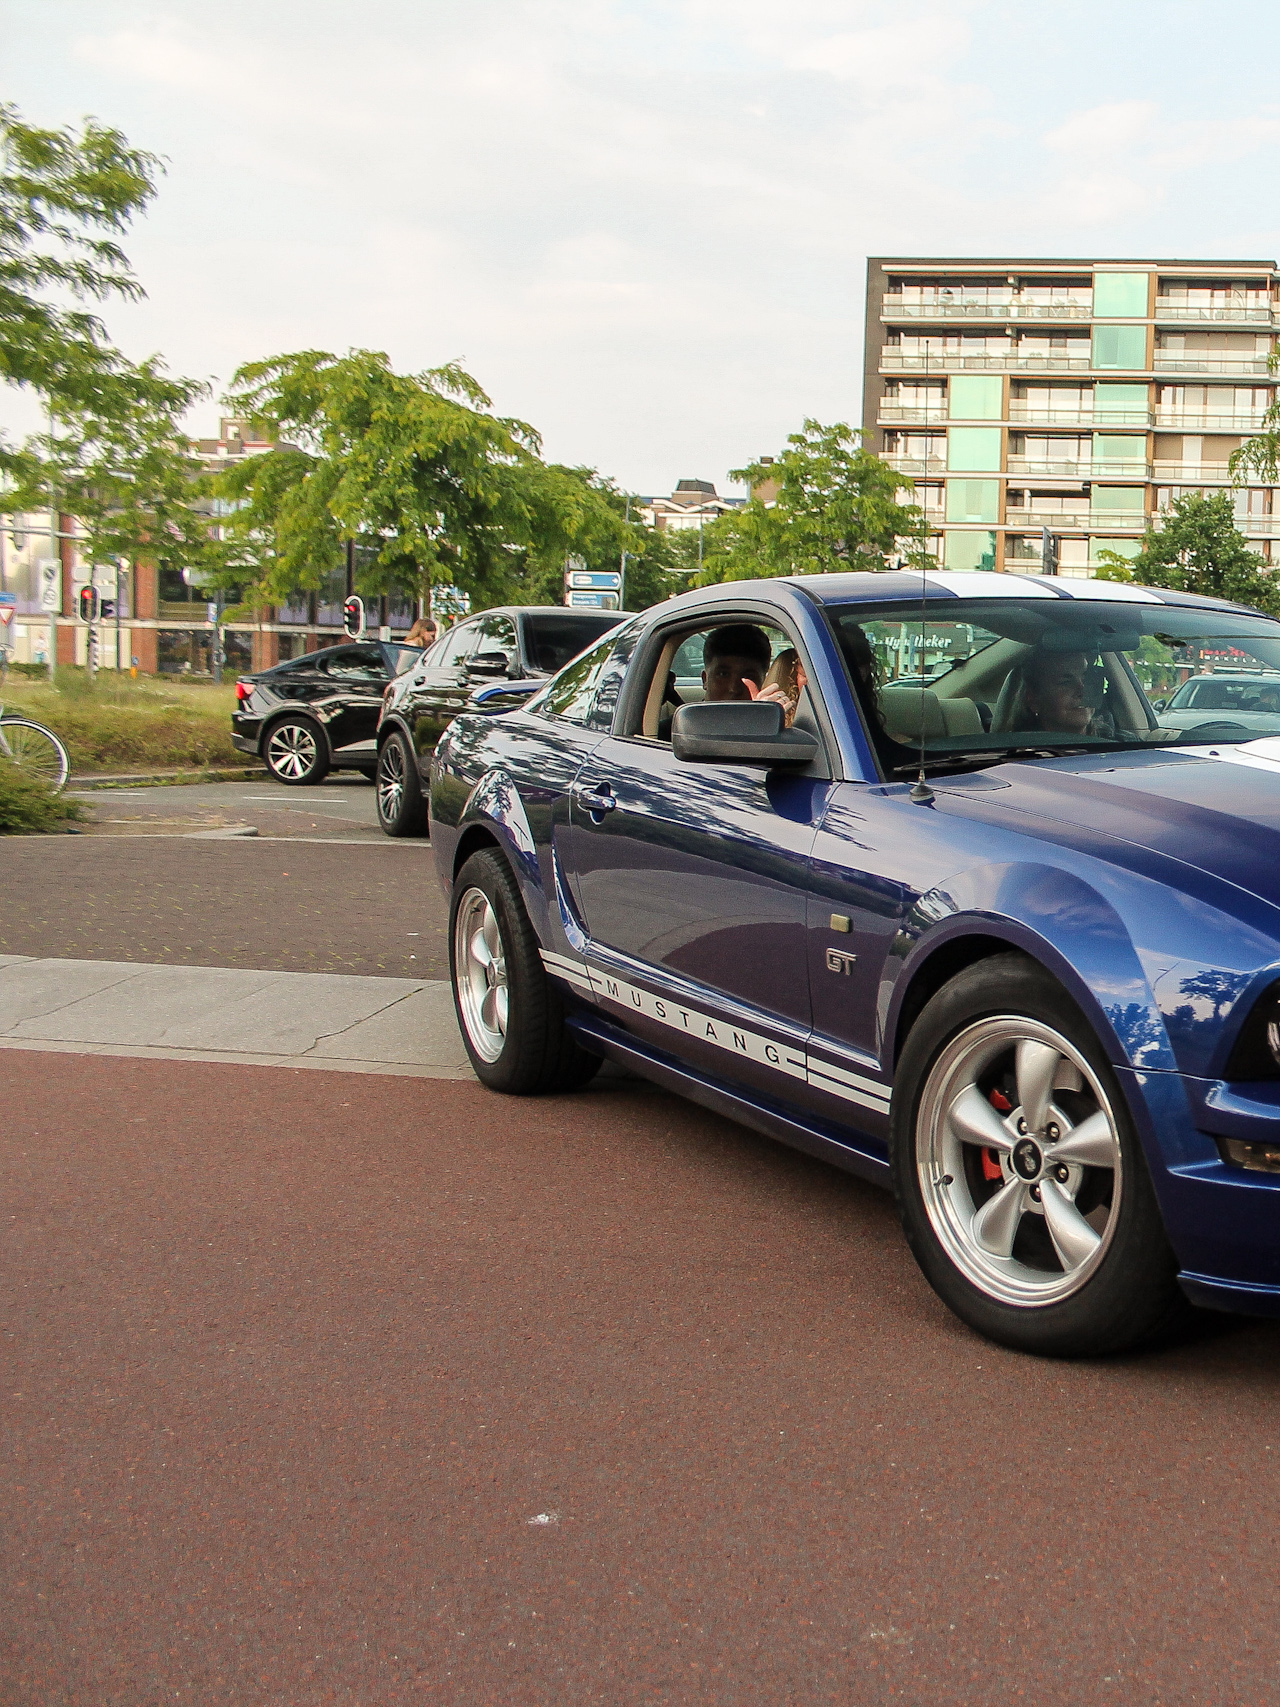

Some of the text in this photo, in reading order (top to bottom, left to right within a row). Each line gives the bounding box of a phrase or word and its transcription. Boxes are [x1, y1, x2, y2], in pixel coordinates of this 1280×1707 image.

[885, 634, 952, 650] Hytheker
[826, 947, 857, 976] GT
[606, 979, 781, 1064] MUSTANG
